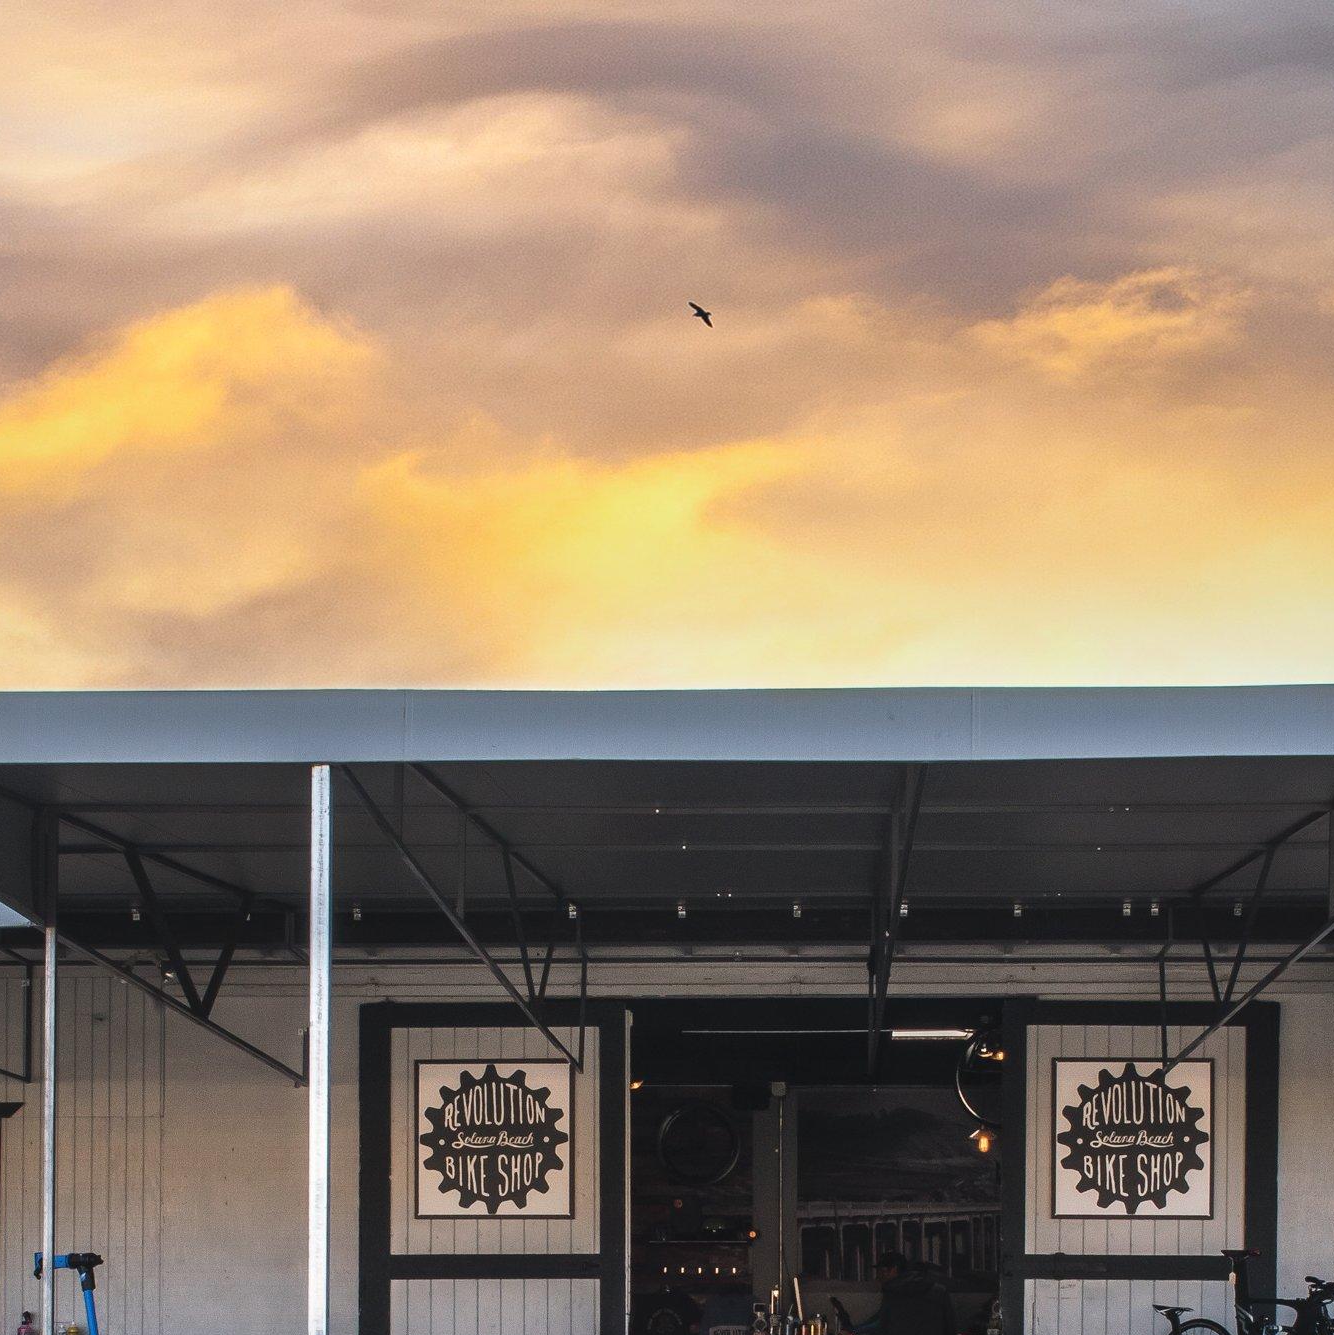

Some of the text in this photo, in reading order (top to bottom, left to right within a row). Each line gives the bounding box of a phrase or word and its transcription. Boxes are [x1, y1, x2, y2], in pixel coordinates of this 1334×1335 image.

[444, 1082, 546, 1131] REVOLUTION
[1082, 1080, 1186, 1130] REVOLUTION
[452, 1131, 535, 1149] Solana Beach
[1089, 1129, 1175, 1148] Solana Beach
[445, 1152, 544, 1197] BIKE SHOP
[1083, 1151, 1184, 1197] BIKE SHOP
